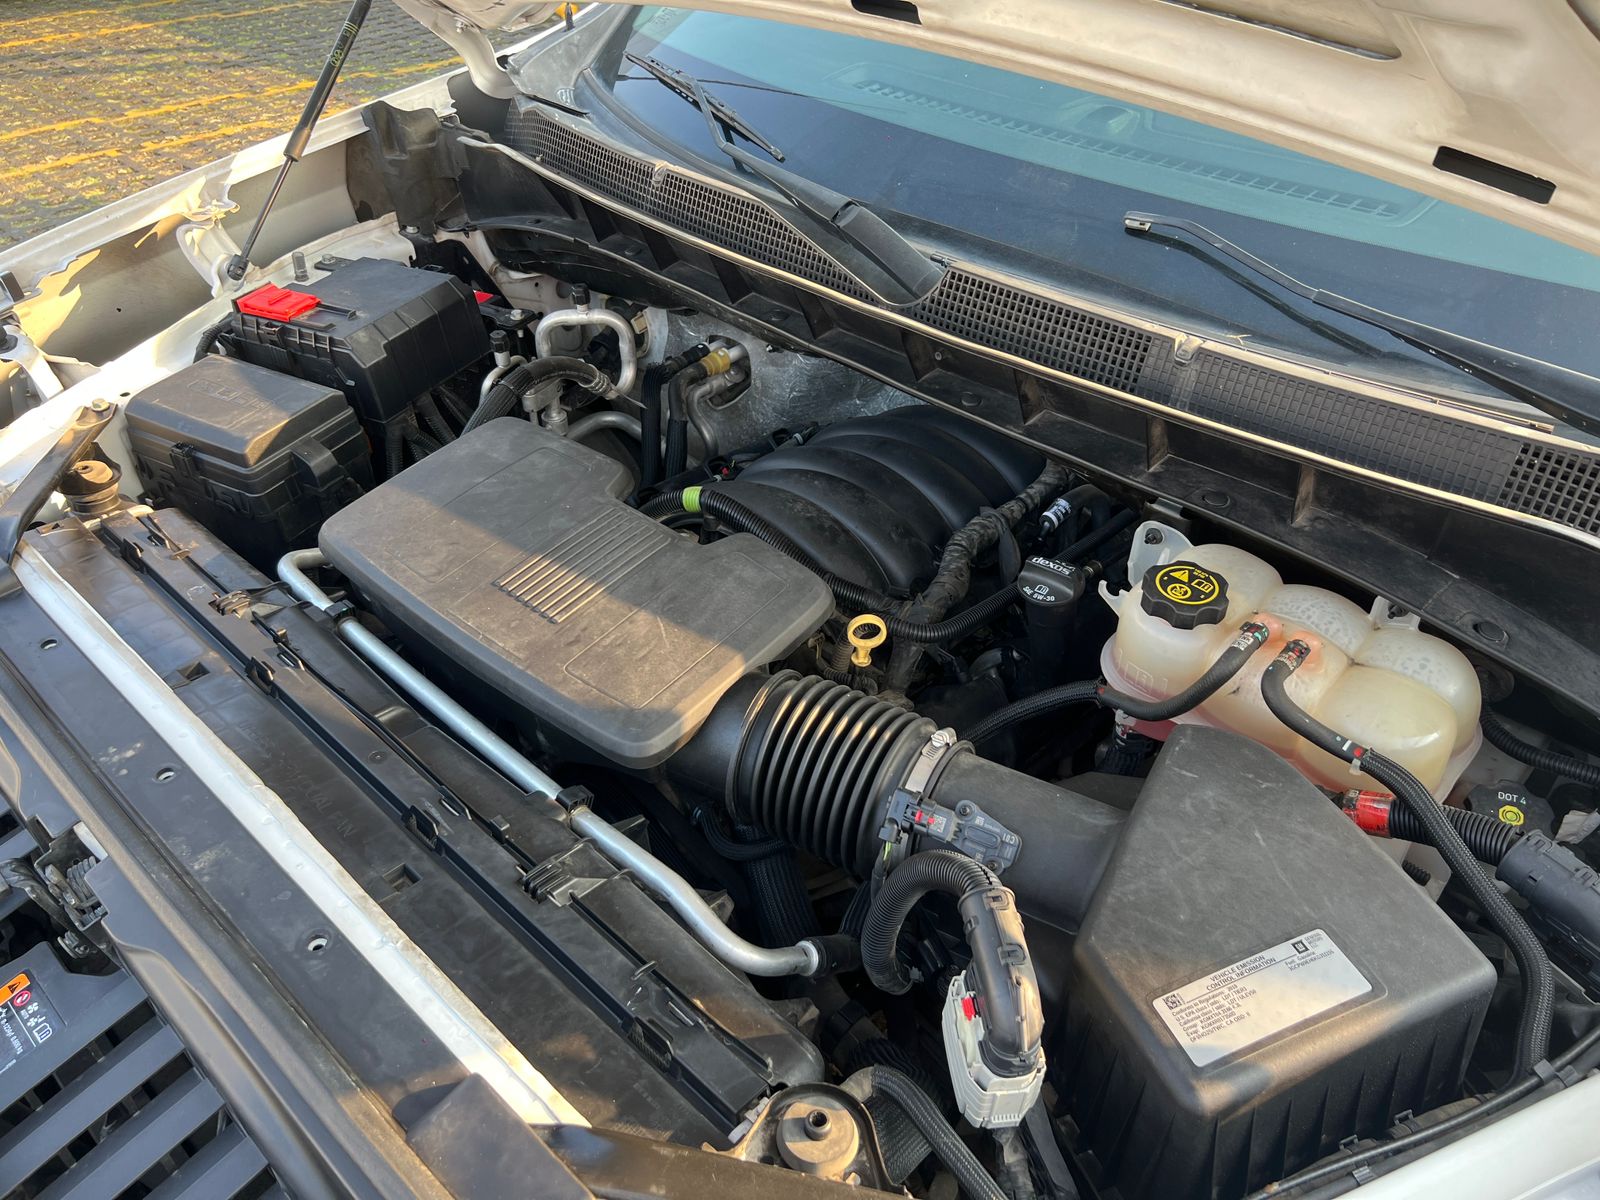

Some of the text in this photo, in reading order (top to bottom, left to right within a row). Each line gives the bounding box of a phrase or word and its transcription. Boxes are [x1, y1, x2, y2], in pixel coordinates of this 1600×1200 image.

[1032, 557, 1071, 575] dexos
[1023, 586, 1033, 595] SAE
[1498, 792, 1518, 802] DOT
[1206, 976, 1236, 991] CONTROL
[1235, 958, 1276, 978] INFORMATION
[1210, 955, 1265, 981] VEHICLE EMISSION
